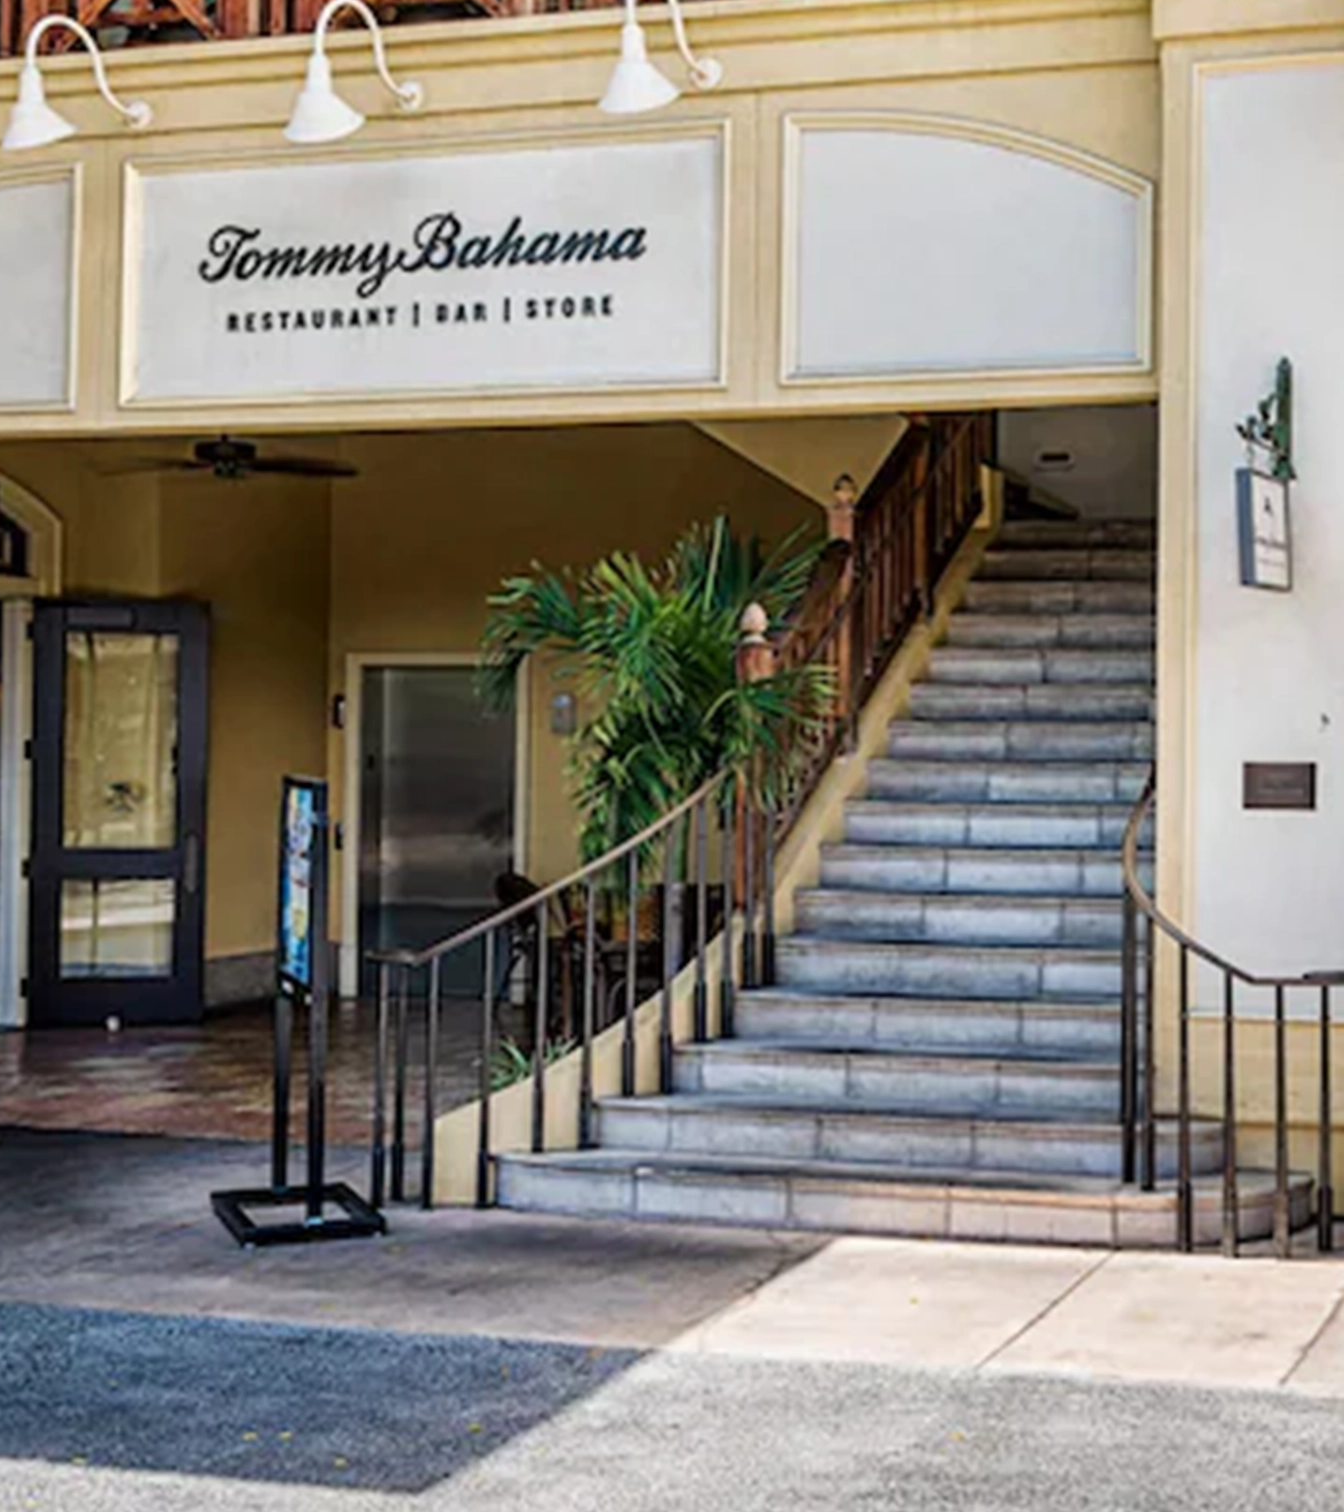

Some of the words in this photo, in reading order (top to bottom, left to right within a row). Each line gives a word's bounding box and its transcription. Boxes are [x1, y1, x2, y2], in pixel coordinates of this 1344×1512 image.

[198, 224, 403, 300] Tommy
[399, 212, 648, 274] Bahama
[225, 306, 398, 333] RESTAURANT
[435, 302, 488, 324] BAR
[526, 295, 612, 319] STORE
